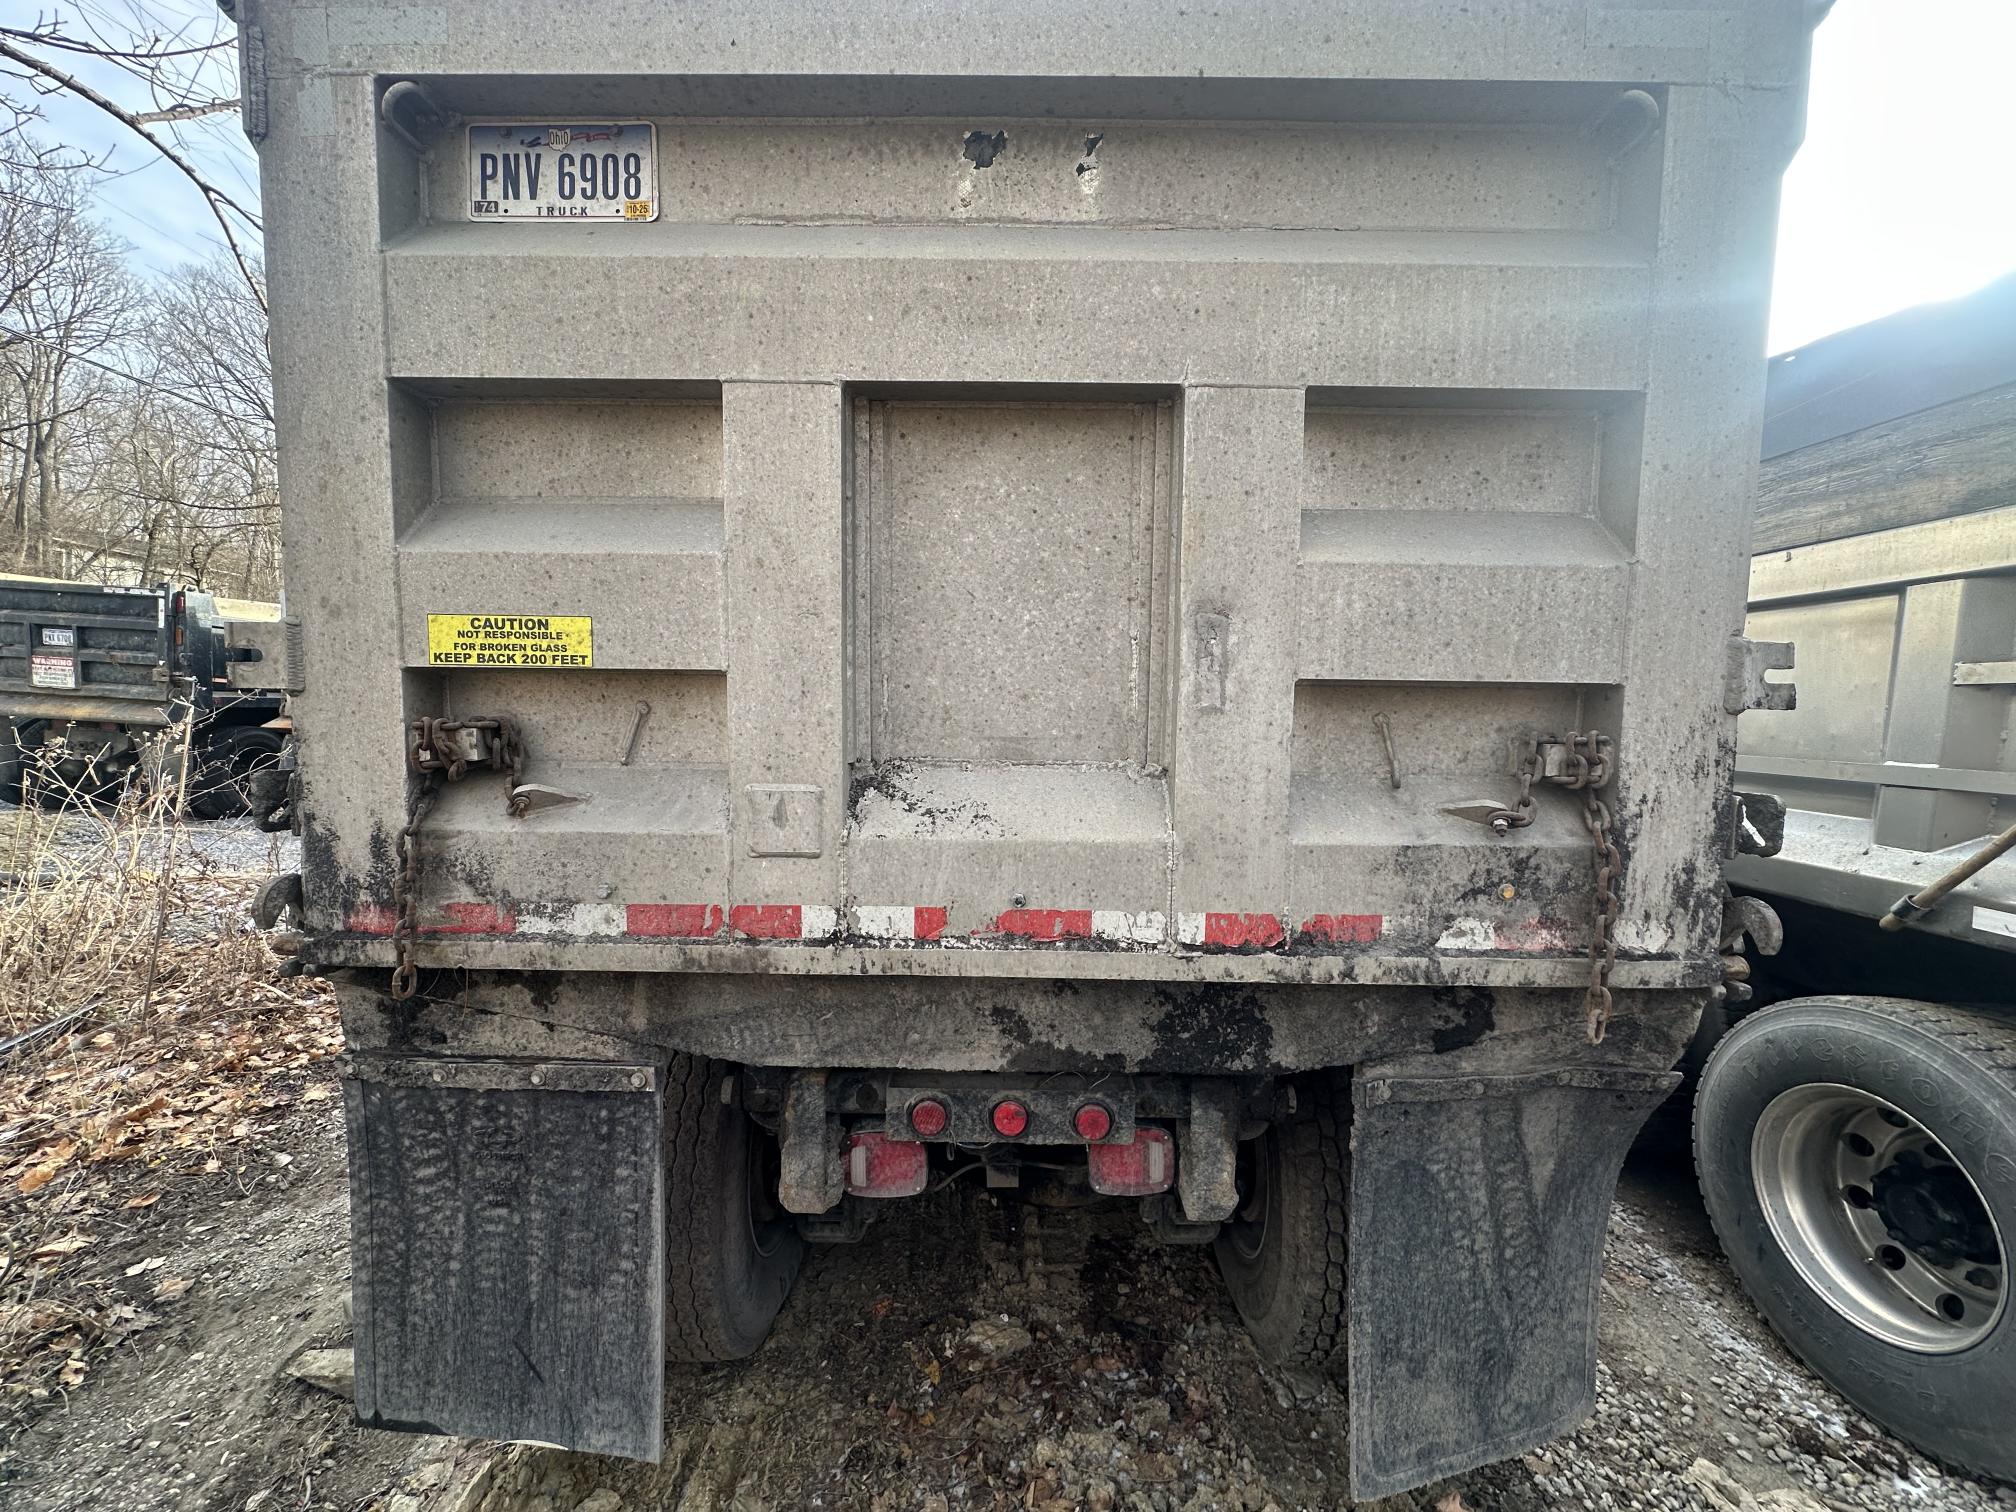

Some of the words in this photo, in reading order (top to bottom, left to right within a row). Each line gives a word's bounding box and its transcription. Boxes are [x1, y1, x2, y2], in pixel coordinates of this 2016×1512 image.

[549, 132, 569, 146] Ohio
[480, 153, 541, 200] PNV
[558, 153, 642, 200] 6908
[480, 202, 496, 212] 74
[536, 206, 589, 216] TRUCK
[630, 204, 648, 214] 10-25
[470, 617, 549, 630] CAUTION
[457, 630, 481, 639] NOT
[484, 631, 563, 640] RESPONSIBLE
[453, 642, 476, 651] FOR
[480, 643, 527, 652] BROKEN
[531, 643, 568, 653] GLASS
[32, 657, 73, 667] WARNING
[433, 652, 472, 663] KEEP
[476, 653, 517, 664] BACK
[521, 654, 547, 664] 200
[552, 654, 589, 665] FEET
